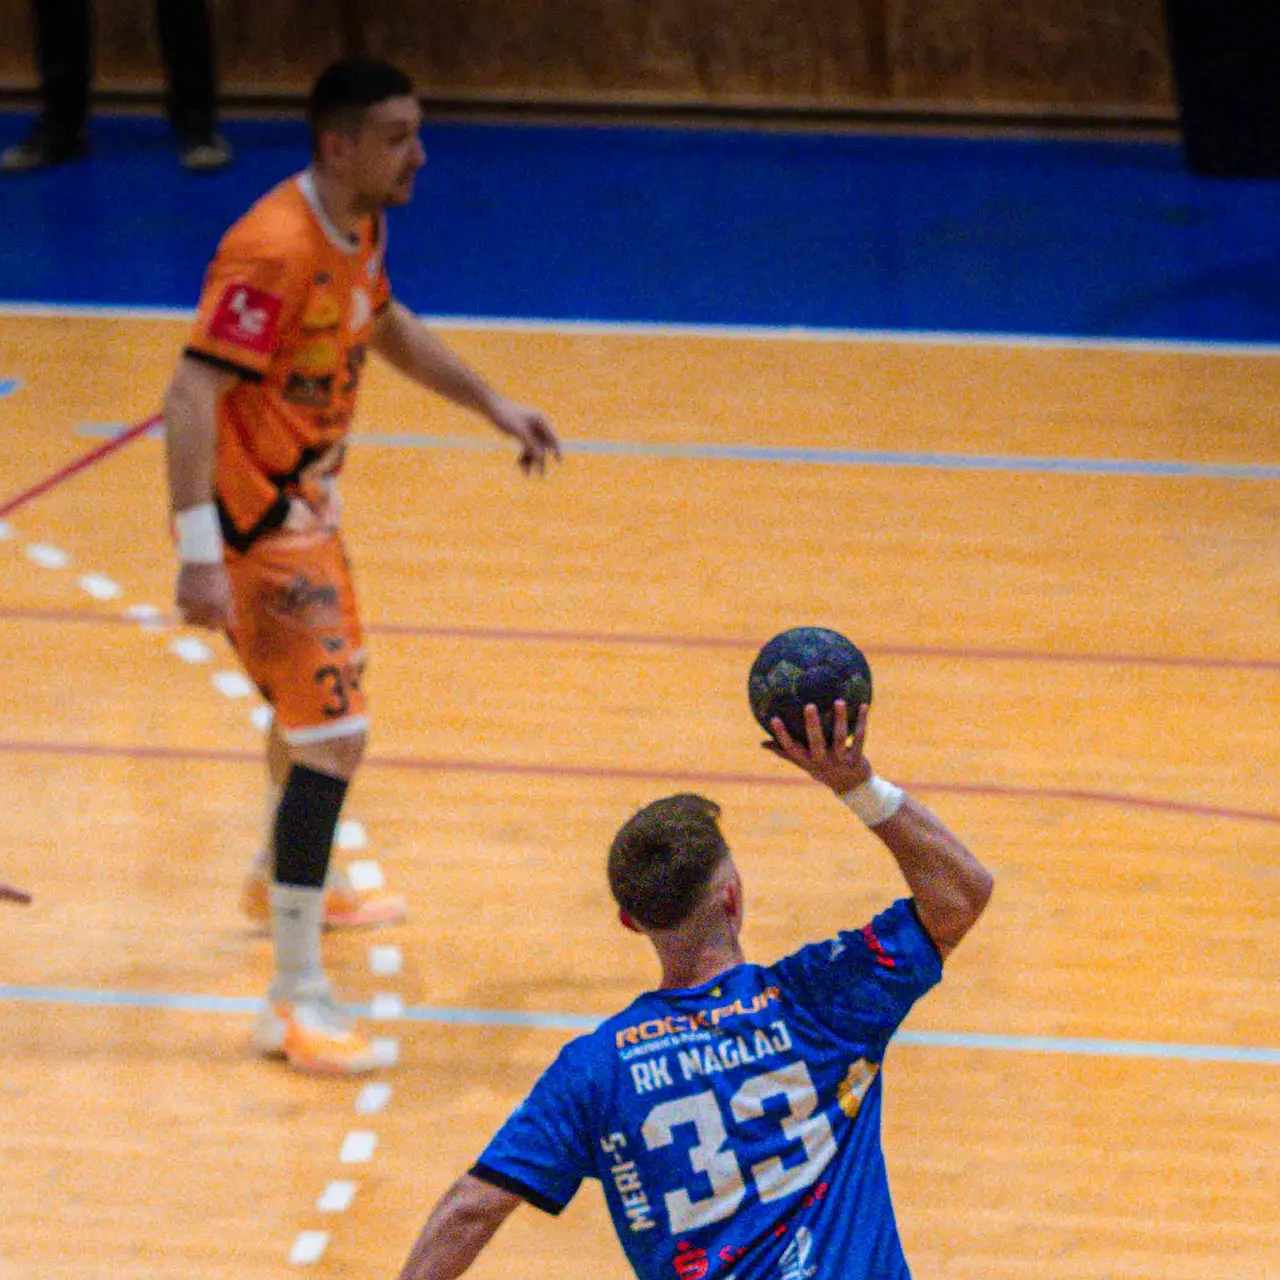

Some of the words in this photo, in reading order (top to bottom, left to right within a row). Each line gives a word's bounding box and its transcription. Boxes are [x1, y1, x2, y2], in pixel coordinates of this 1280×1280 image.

[630, 1052, 673, 1094] RK
[678, 1020, 793, 1082] MAGLAJ
[641, 1061, 838, 1235] 33
